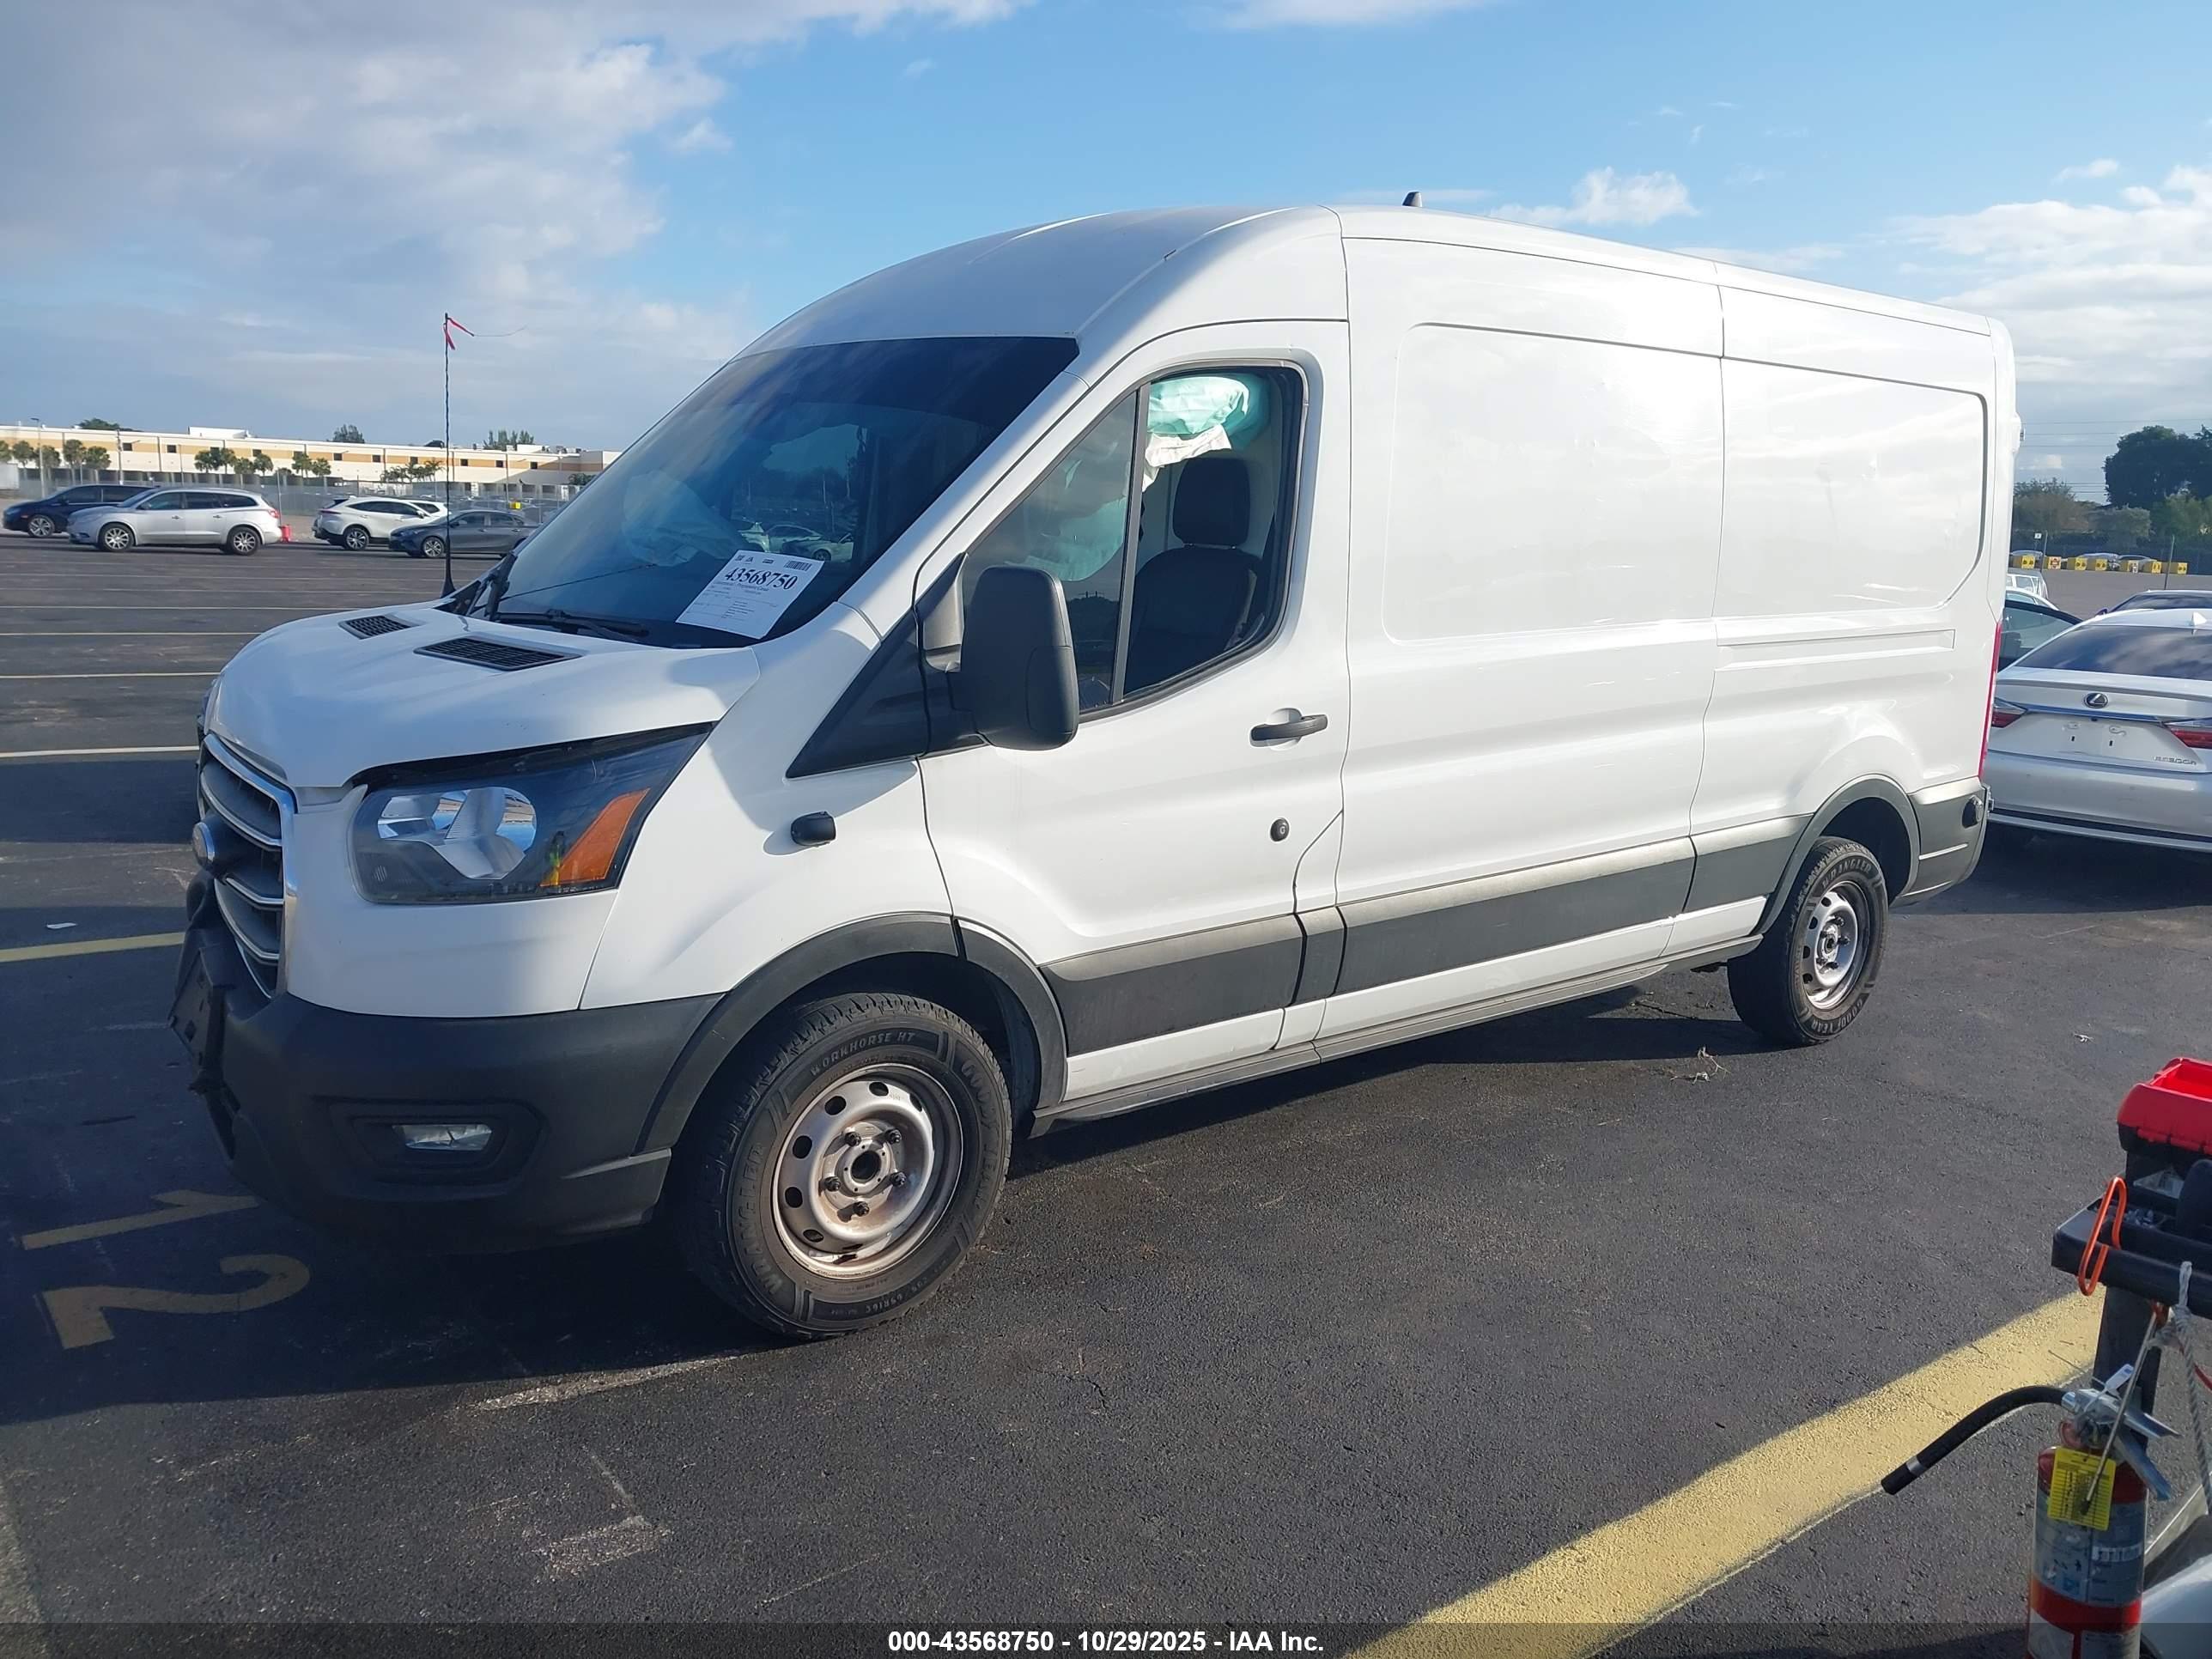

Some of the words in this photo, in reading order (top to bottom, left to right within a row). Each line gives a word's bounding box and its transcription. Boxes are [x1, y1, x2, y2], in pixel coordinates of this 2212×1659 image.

[725, 567, 799, 590] 43568750
[1821, 858, 1872, 889] WRANGLER
[810, 1031, 892, 1077] WORKHORSE
[896, 1031, 917, 1042] HT
[737, 1142, 783, 1295] WRANGLER
